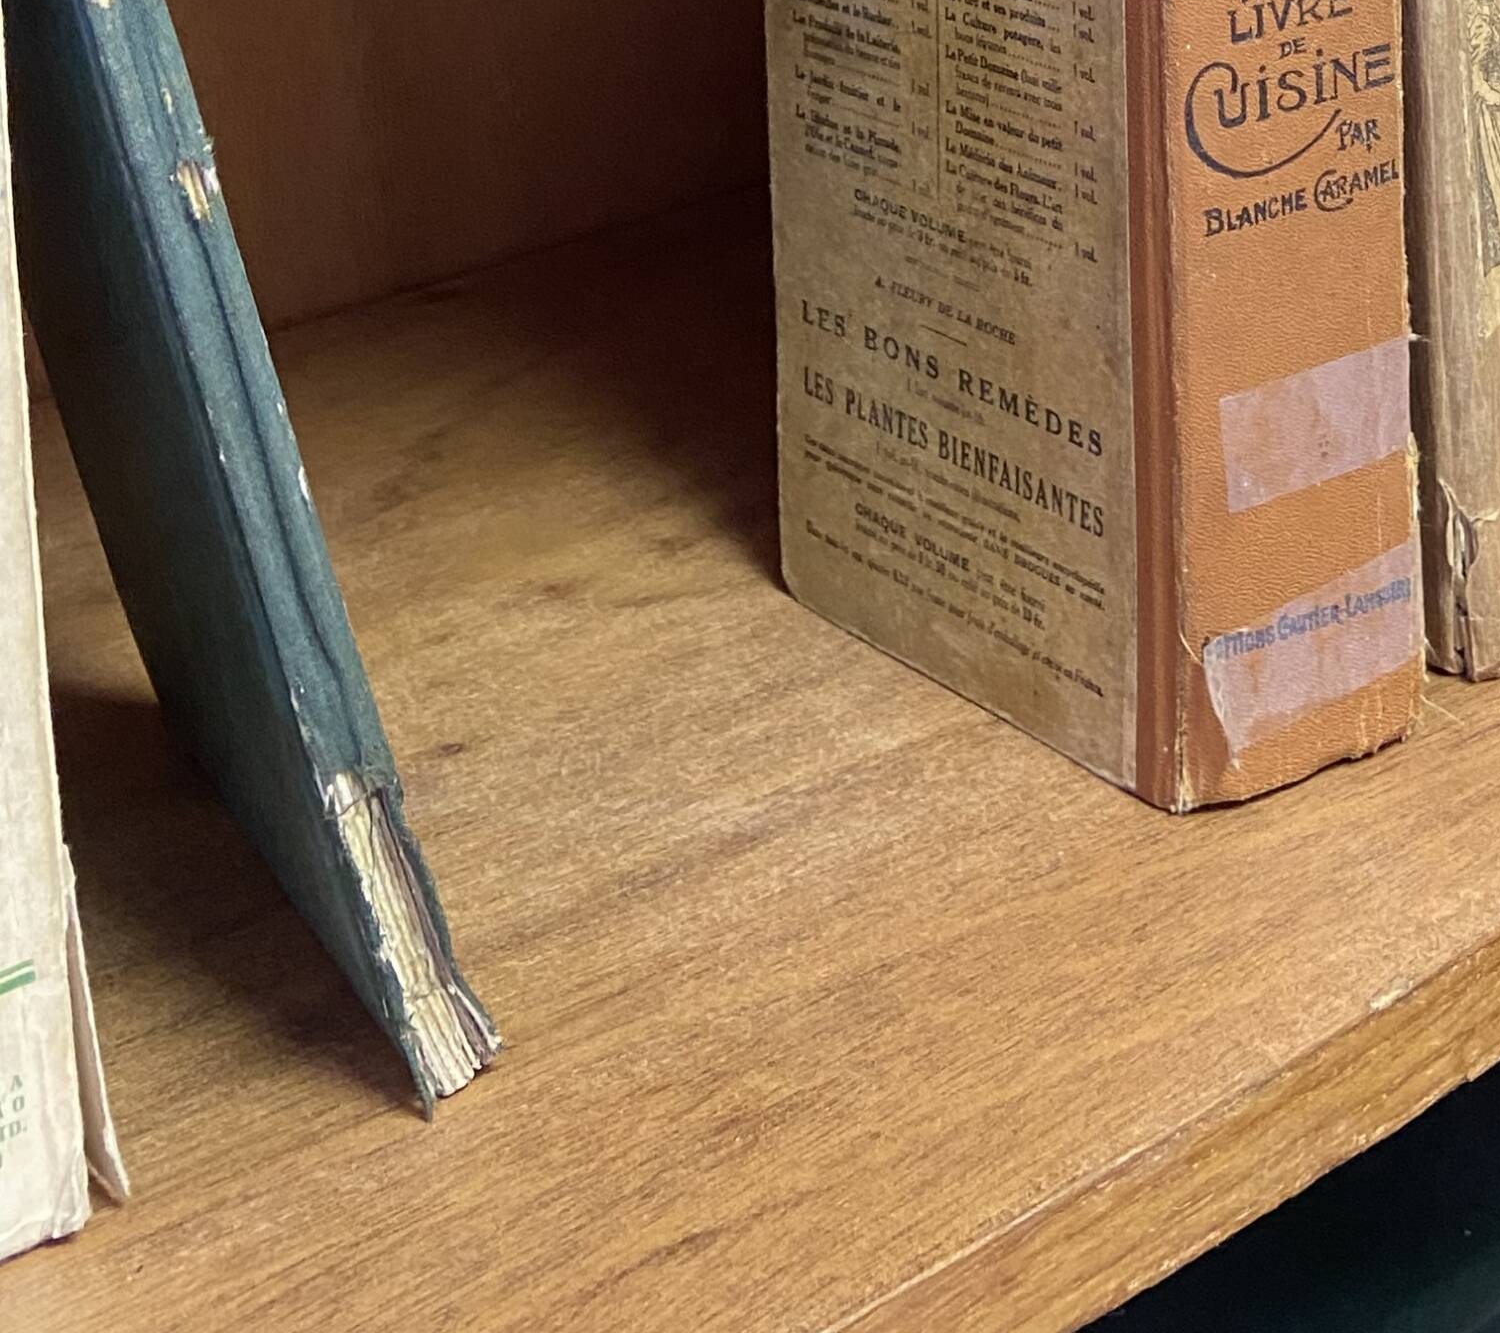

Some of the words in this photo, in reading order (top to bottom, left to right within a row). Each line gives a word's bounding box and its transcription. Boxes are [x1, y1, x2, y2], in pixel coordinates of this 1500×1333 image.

[945, 44, 956, 62] Le
[1278, 37, 1307, 62] DE
[1184, 42, 1395, 181] CUISINE
[1334, 117, 1381, 153] PAR
[854, 188, 908, 219] CHAQUE
[1204, 187, 1309, 238] BLANCHE
[1313, 156, 1401, 213] CARAMEL
[938, 300, 954, 319] DE
[957, 309, 972, 327] LA
[801, 298, 846, 338] LES
[863, 326, 940, 379] BONS
[958, 368, 1103, 457] REMÈDES
[804, 365, 834, 406] LES
[845, 387, 928, 450] PLANTES
[938, 429, 1104, 538] BIENFAISANTES
